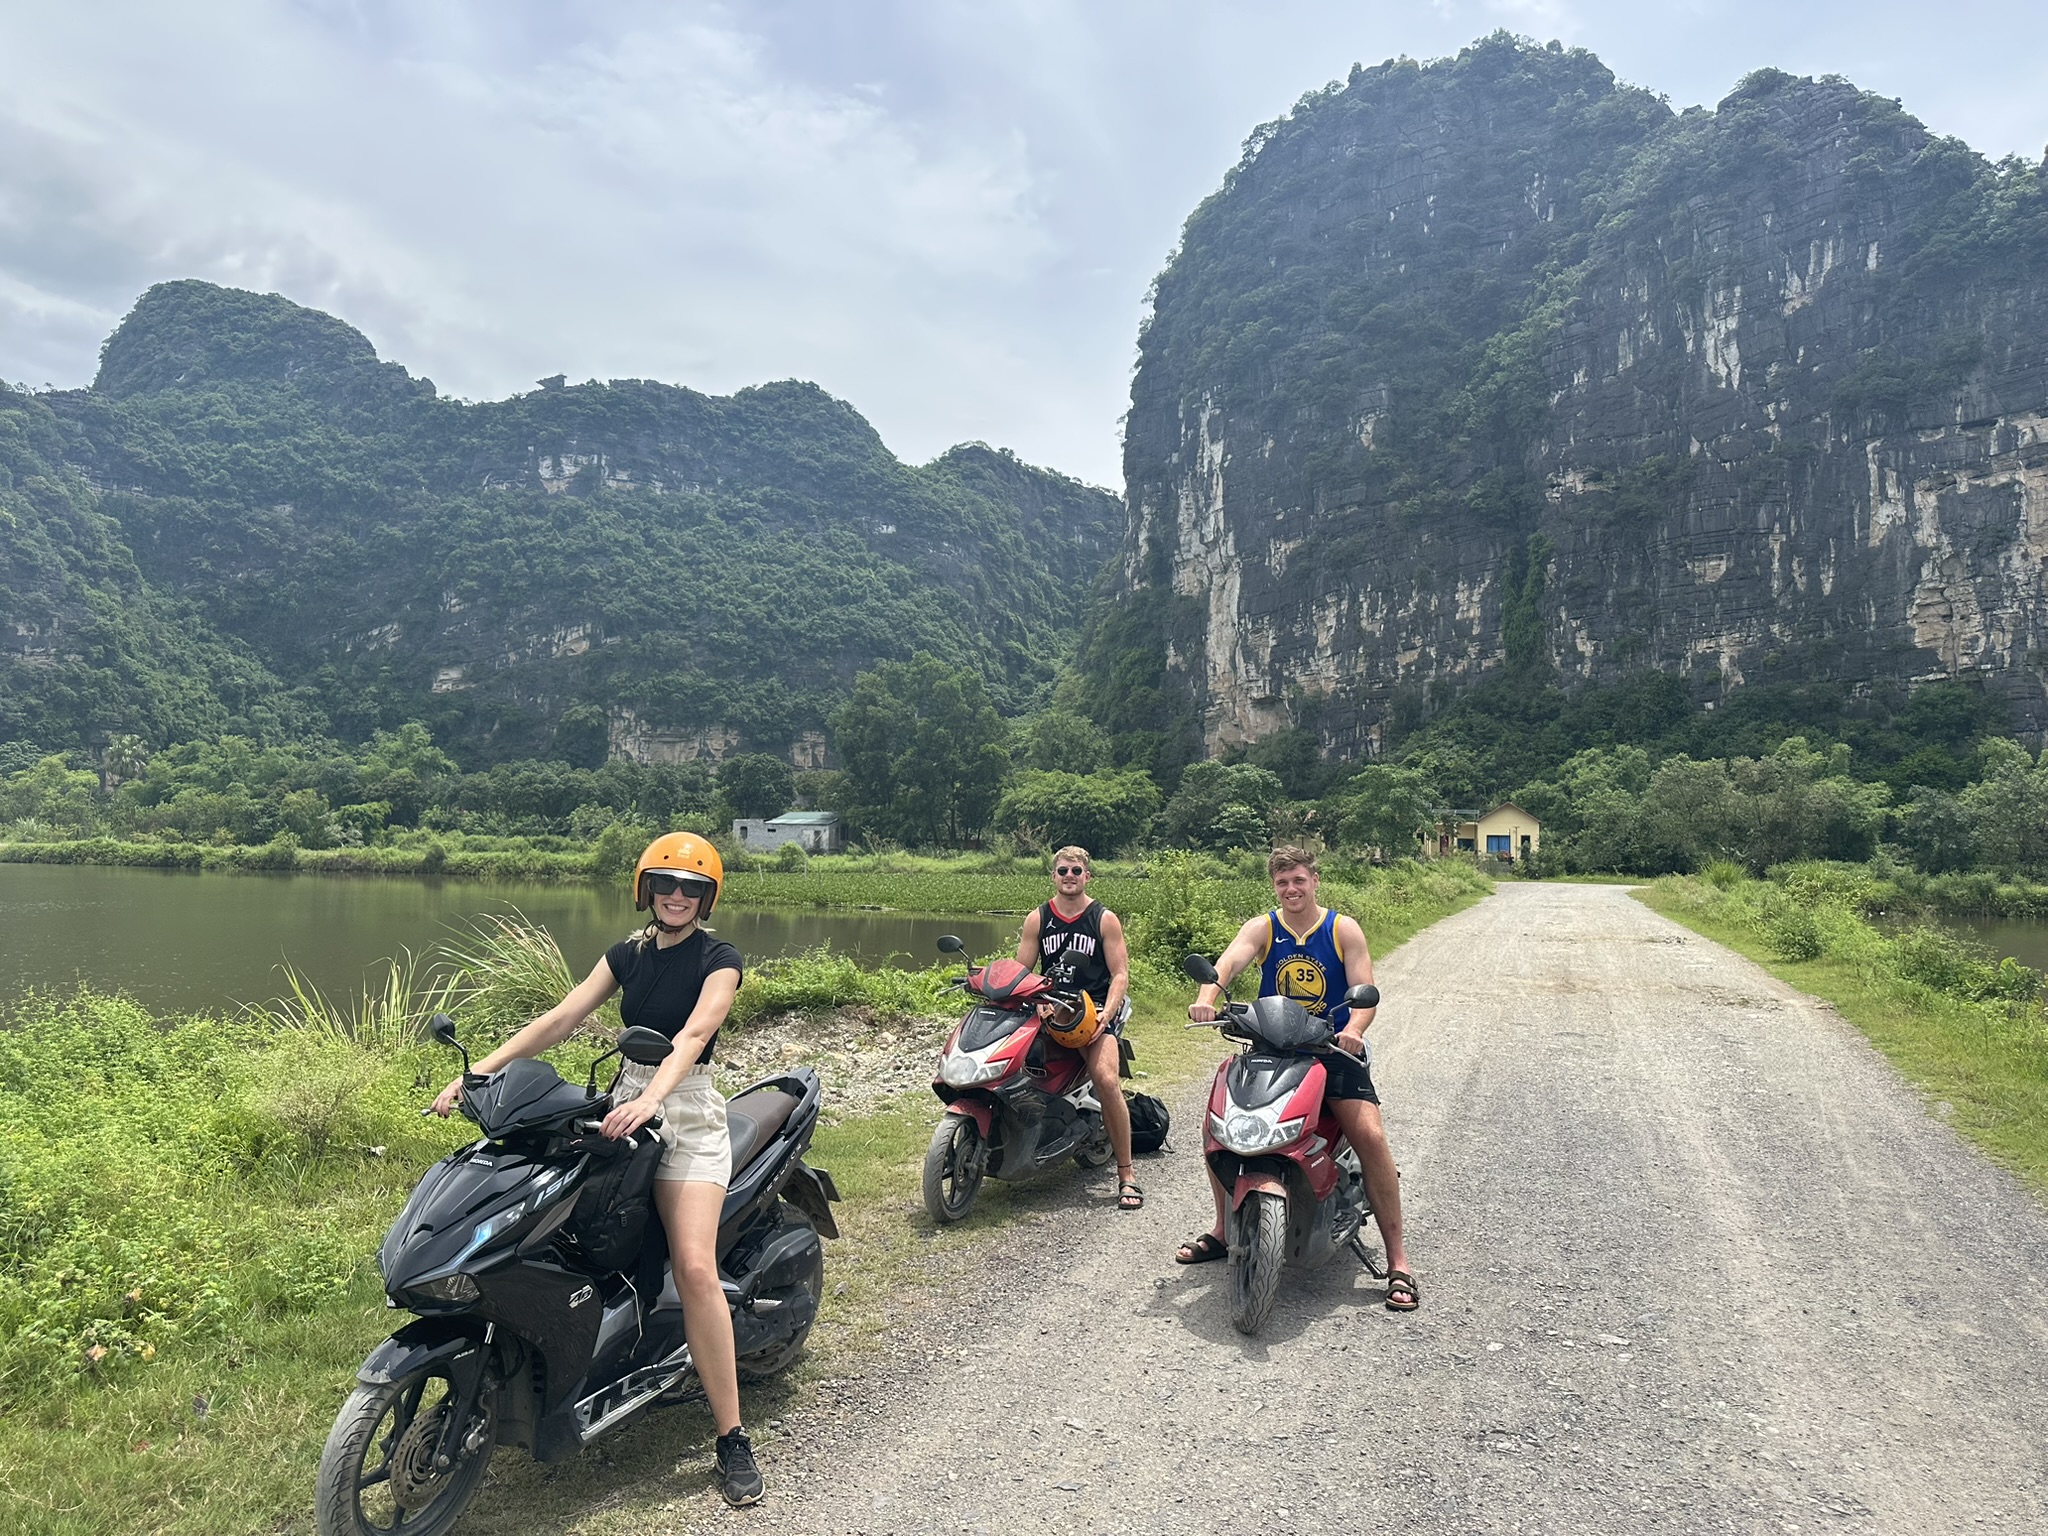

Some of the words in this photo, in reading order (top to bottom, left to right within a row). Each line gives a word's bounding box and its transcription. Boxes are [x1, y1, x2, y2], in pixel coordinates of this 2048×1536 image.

[1275, 953, 1304, 969] GOLDEN
[1305, 955, 1327, 973] STATE
[1296, 968, 1315, 983] 35
[470, 1158, 493, 1167] HONDA
[533, 1164, 582, 1210] 150
